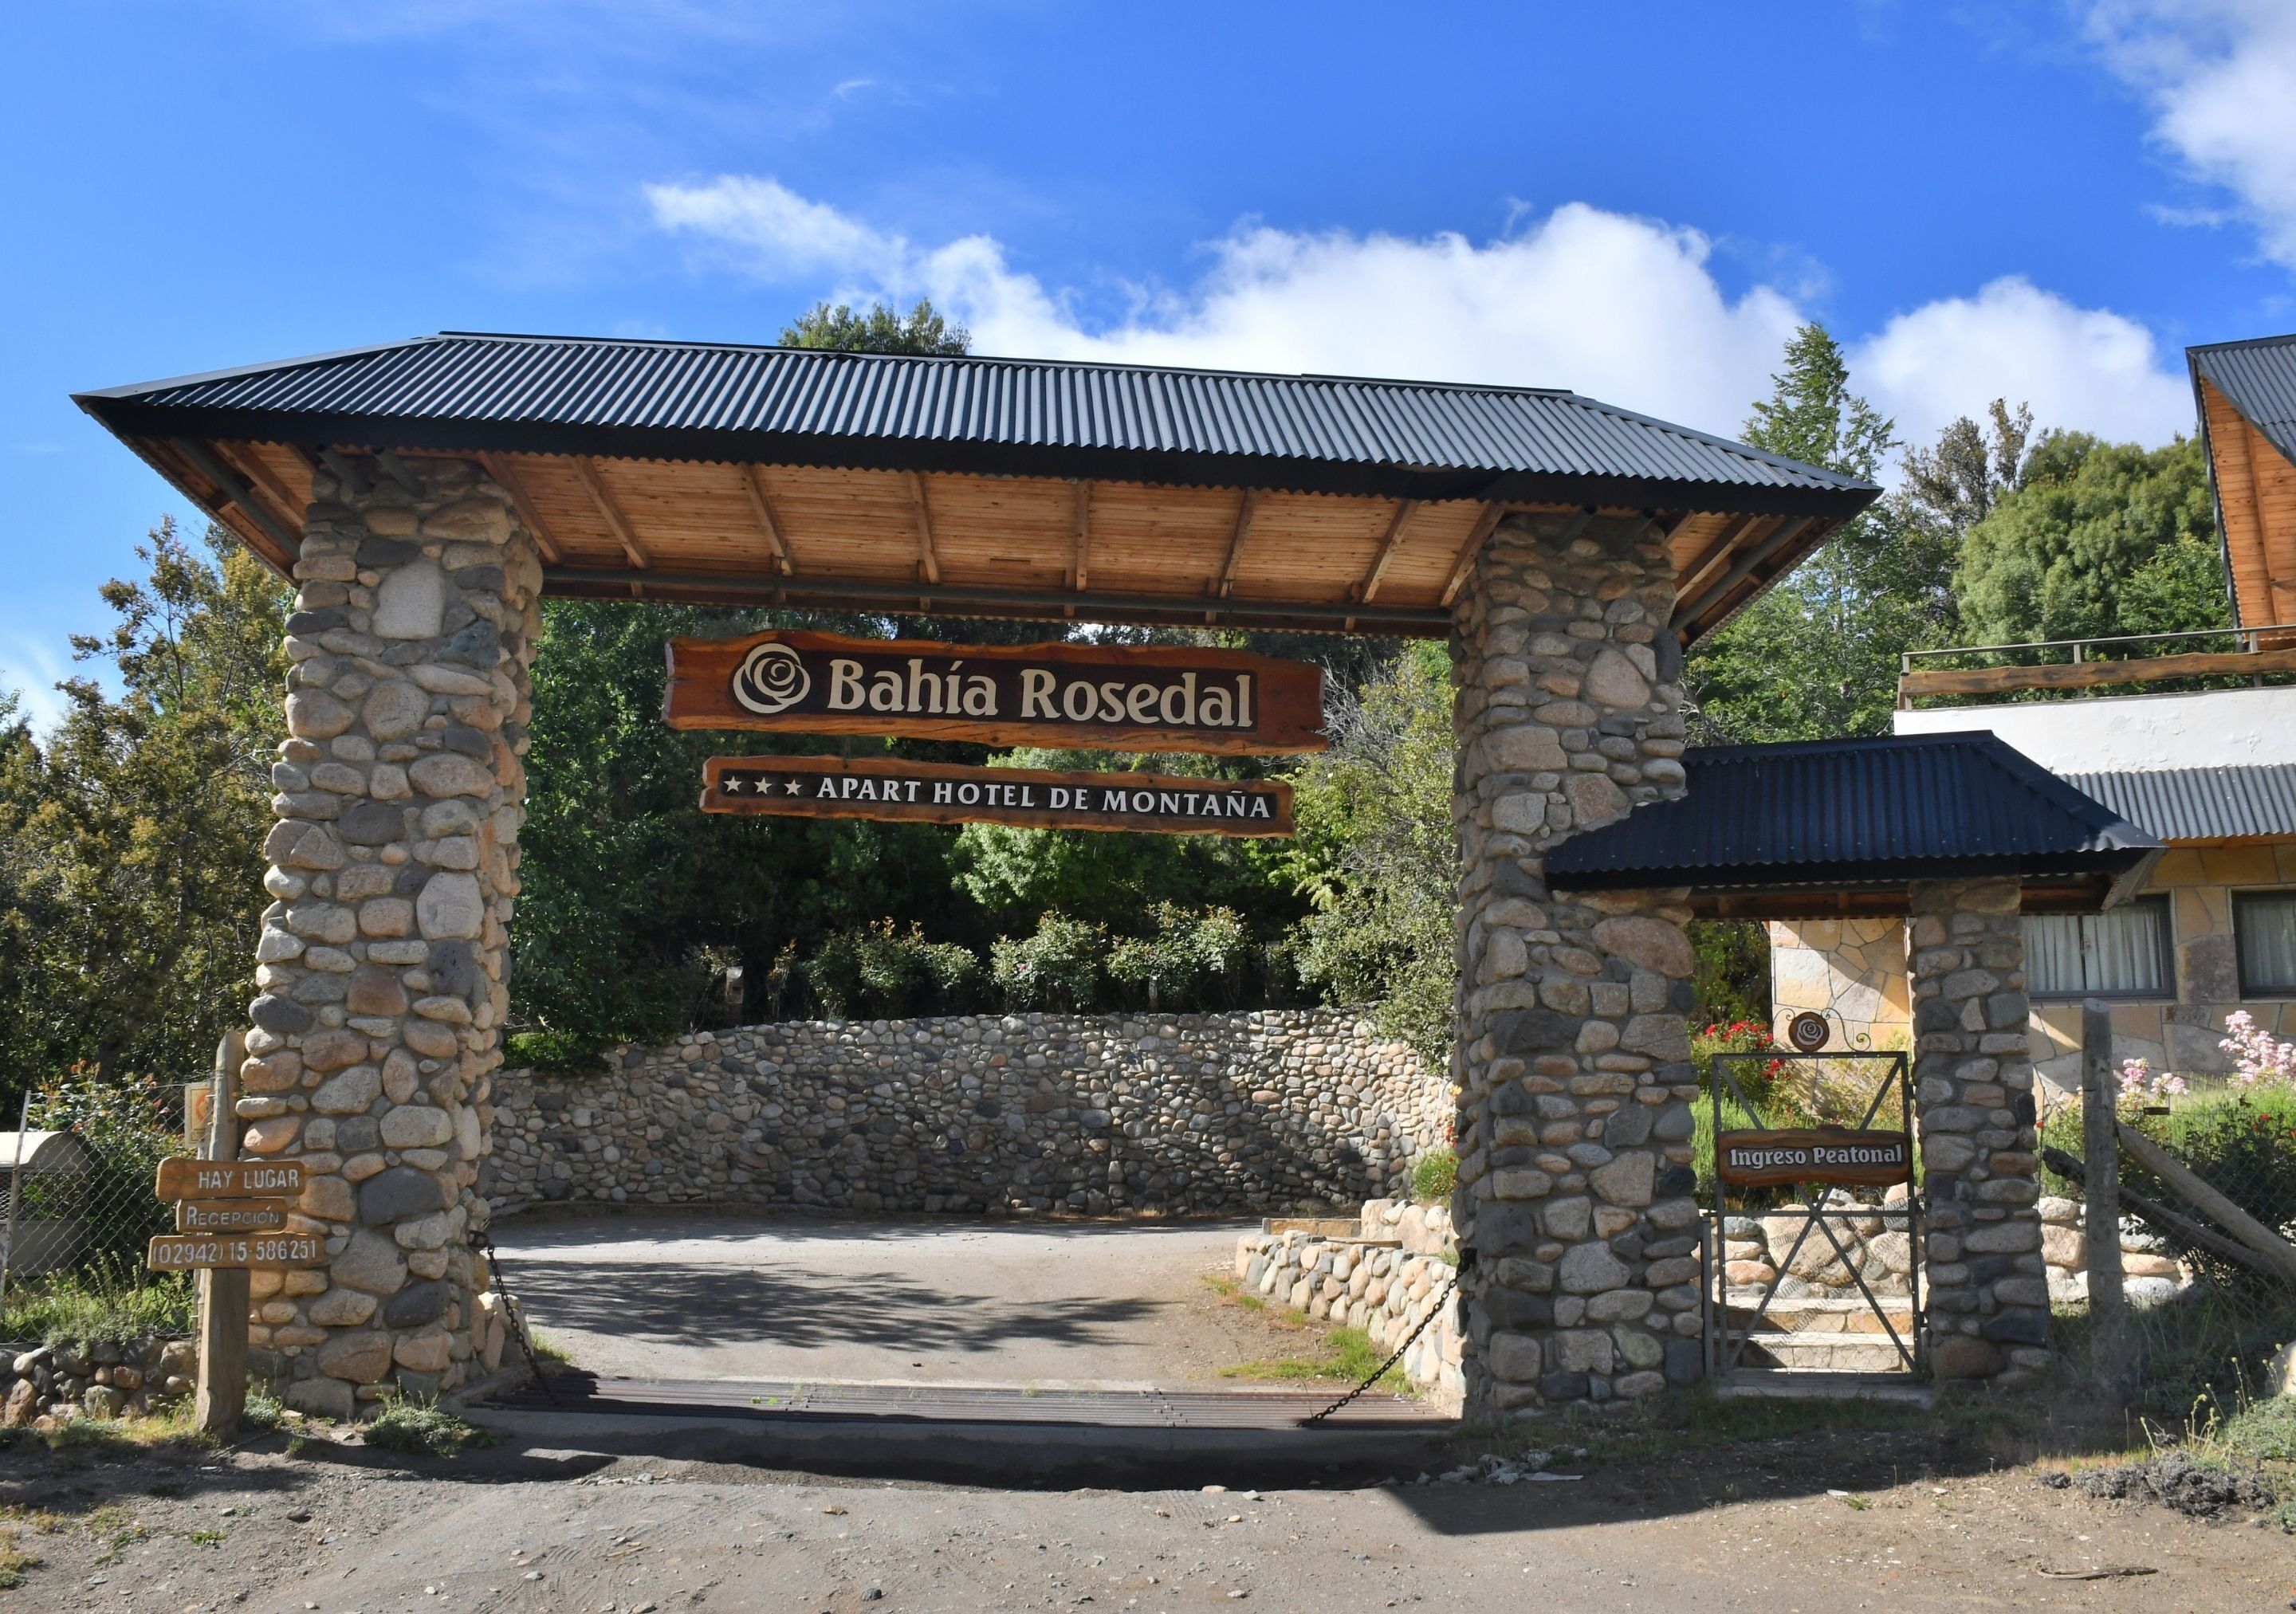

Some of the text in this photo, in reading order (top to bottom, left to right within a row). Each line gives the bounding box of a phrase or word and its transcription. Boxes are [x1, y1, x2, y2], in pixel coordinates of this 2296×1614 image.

[828, 659, 1253, 727] Bahía Rosedal
[816, 777, 1271, 819] APART HOTEL DE MONTAÑA
[1730, 1145, 1903, 1169] Ingreso Peatonal
[199, 1168, 299, 1189] HAY LUGAR
[187, 1205, 279, 1226] RECEPCIÓN
[152, 1243, 224, 1264] (02942)
